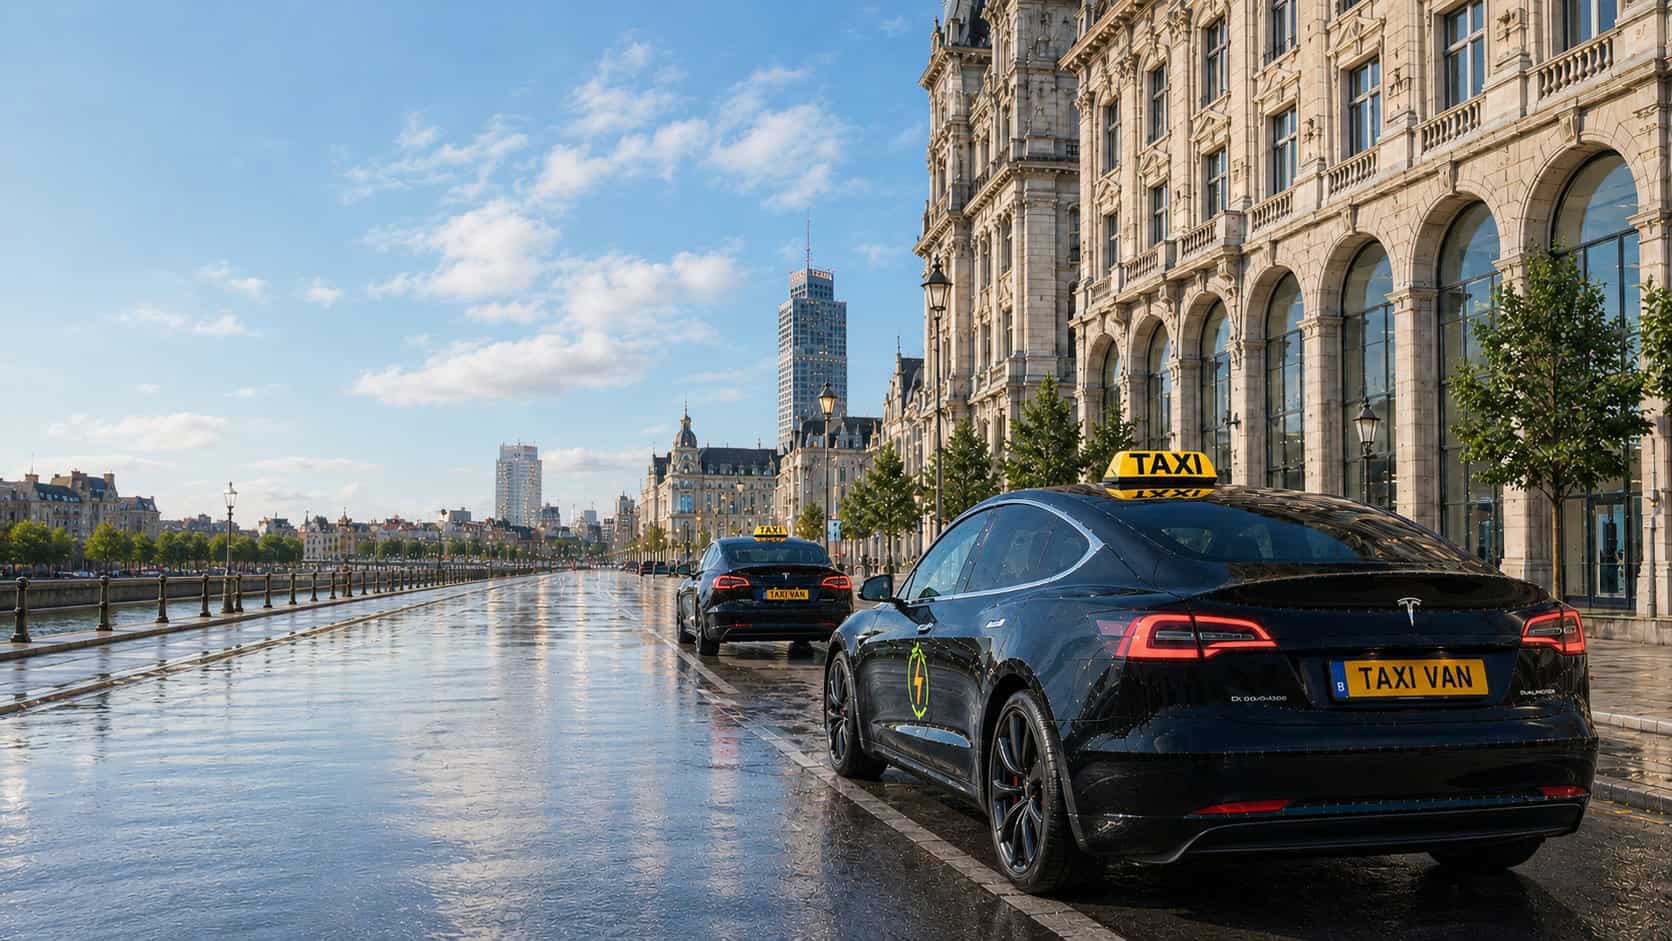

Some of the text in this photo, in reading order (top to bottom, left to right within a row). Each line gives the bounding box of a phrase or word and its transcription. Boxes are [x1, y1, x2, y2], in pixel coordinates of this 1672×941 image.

[1129, 453, 1203, 475] TAXI
[1337, 681, 1345, 692] B
[1358, 665, 1474, 690] TAXI VAN
